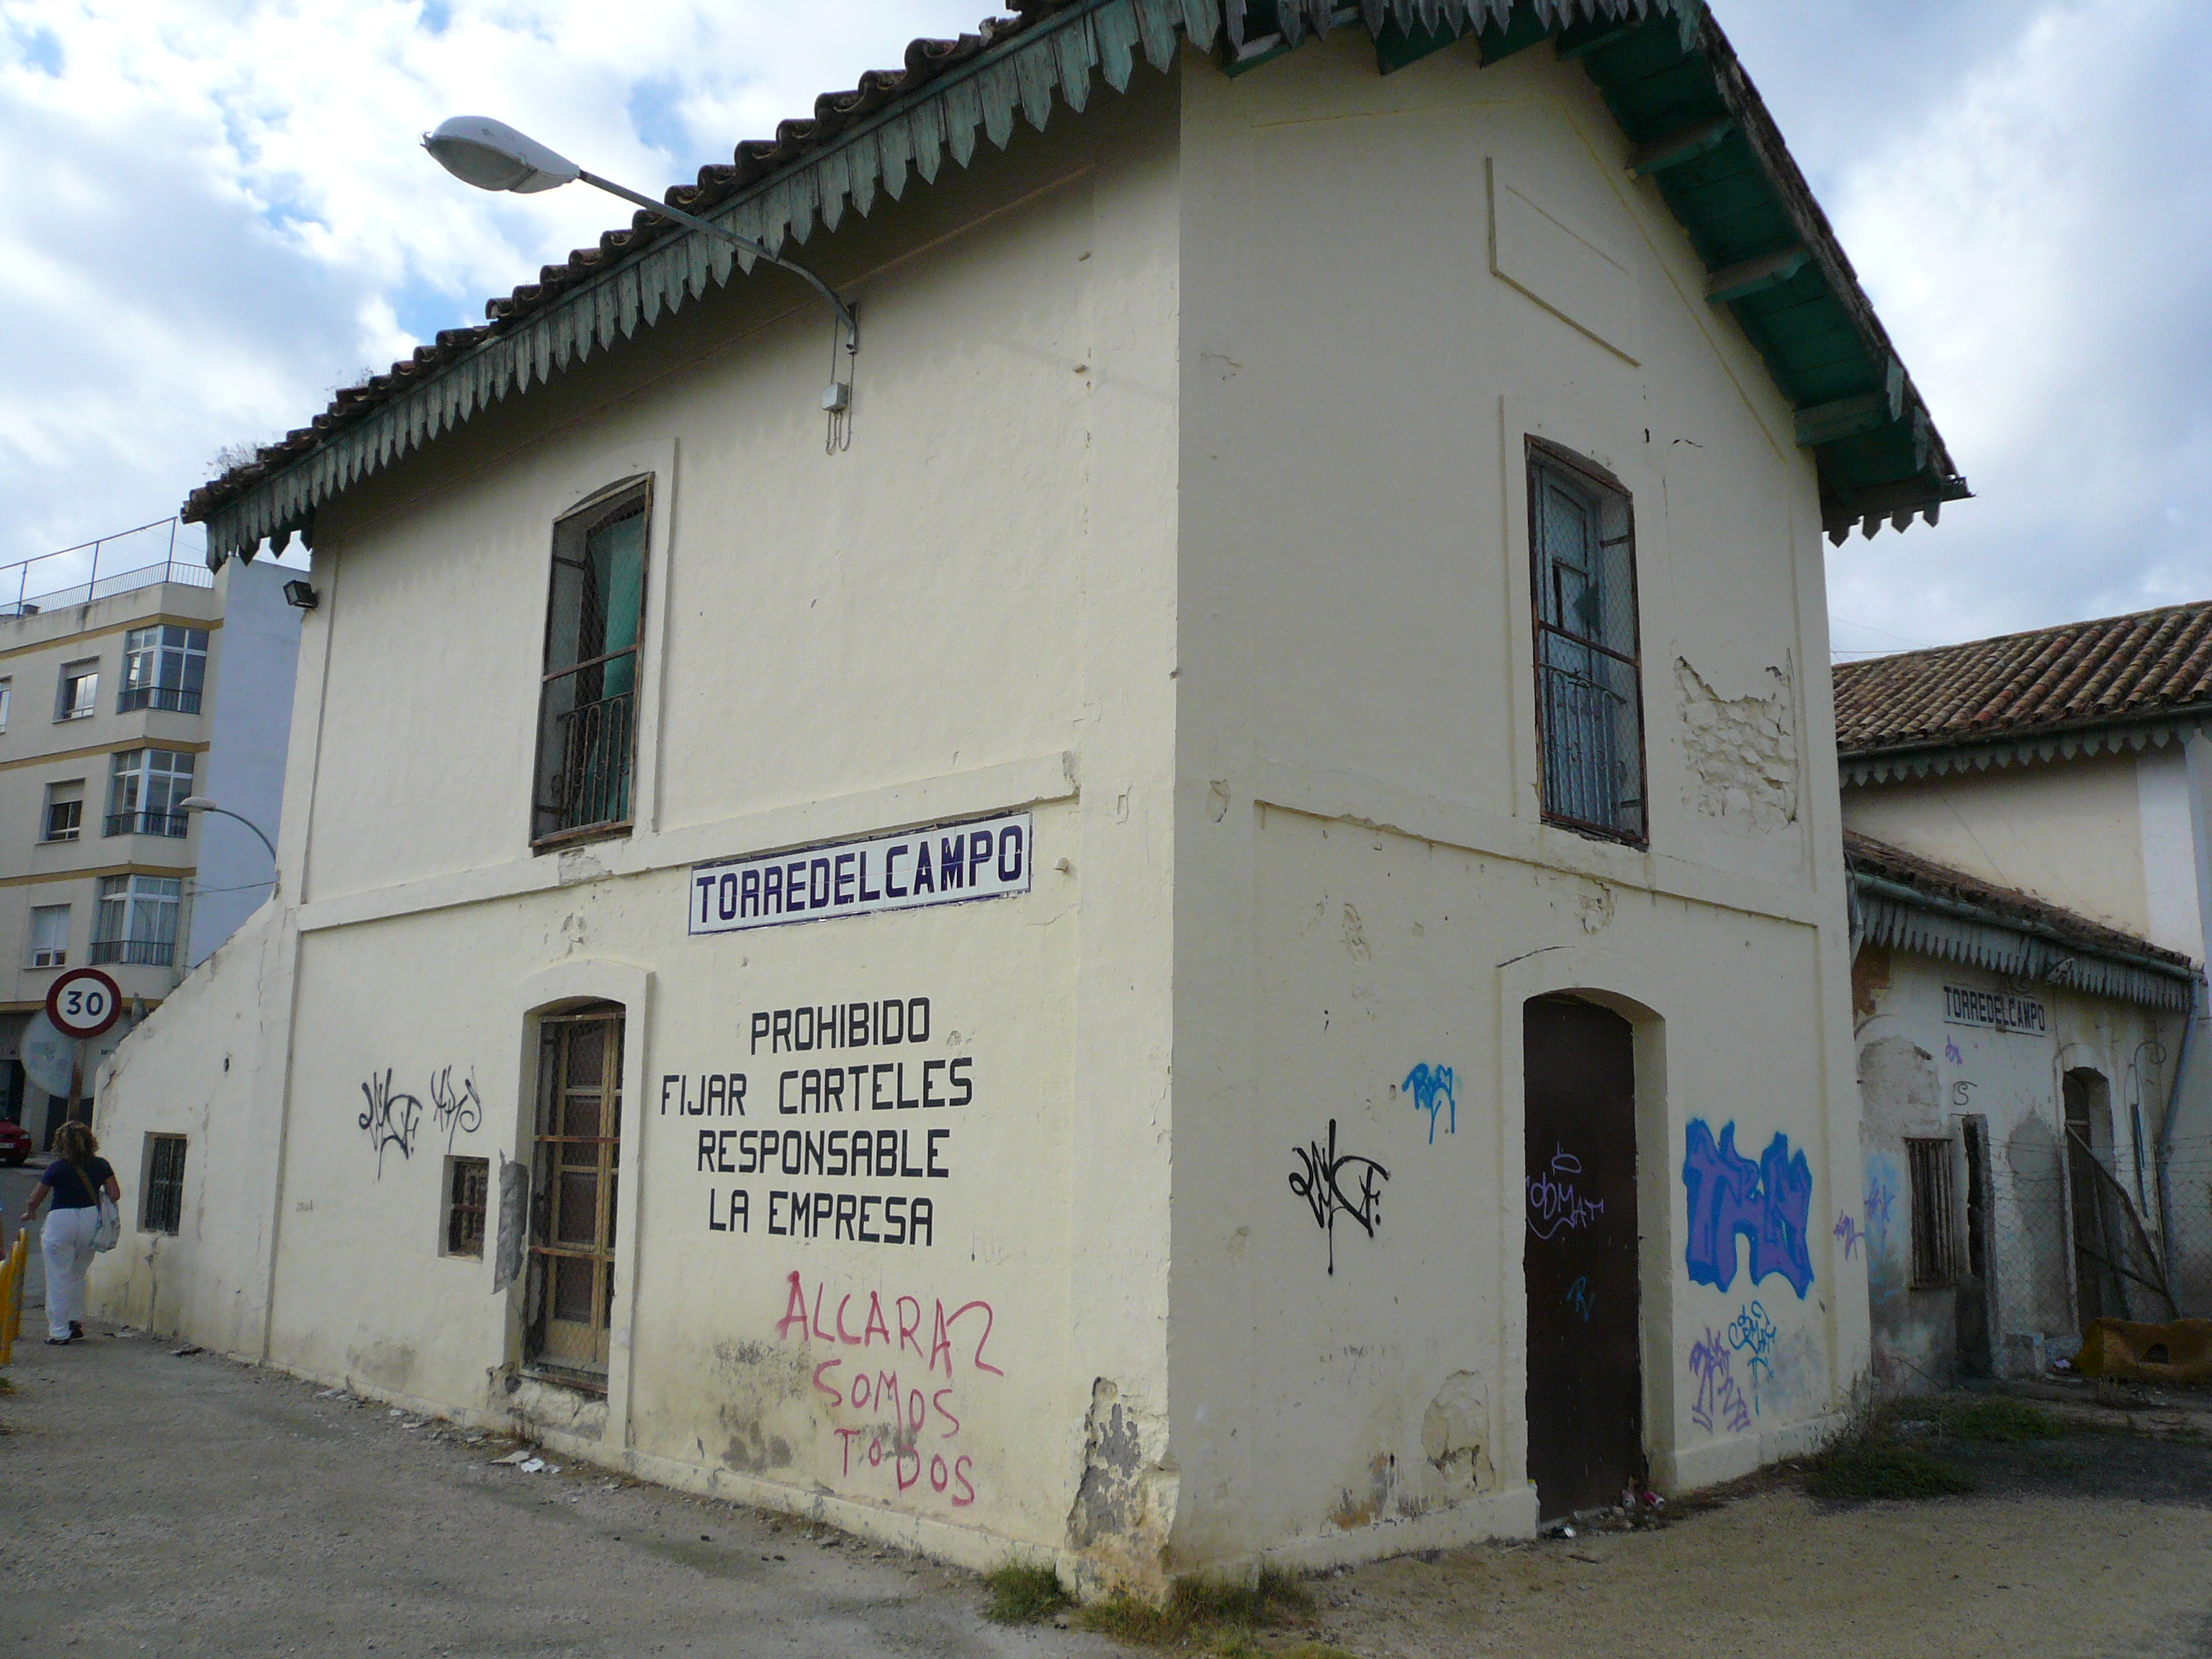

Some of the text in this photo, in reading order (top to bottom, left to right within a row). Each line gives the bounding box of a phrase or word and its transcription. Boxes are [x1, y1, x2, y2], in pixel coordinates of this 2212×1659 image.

[696, 824, 1023, 923] TORREDELCAMPO
[66, 990, 105, 1017] 30
[751, 997, 930, 1056] PROHIBIDO
[1943, 986, 2046, 1031] TORREDELCAMPO
[661, 1056, 972, 1116] FIJAR CARTELES
[697, 1129, 950, 1178] RESPONSABLE
[709, 1188, 933, 1246] LA EMPRESA
[813, 1359, 960, 1439] SOMOS
